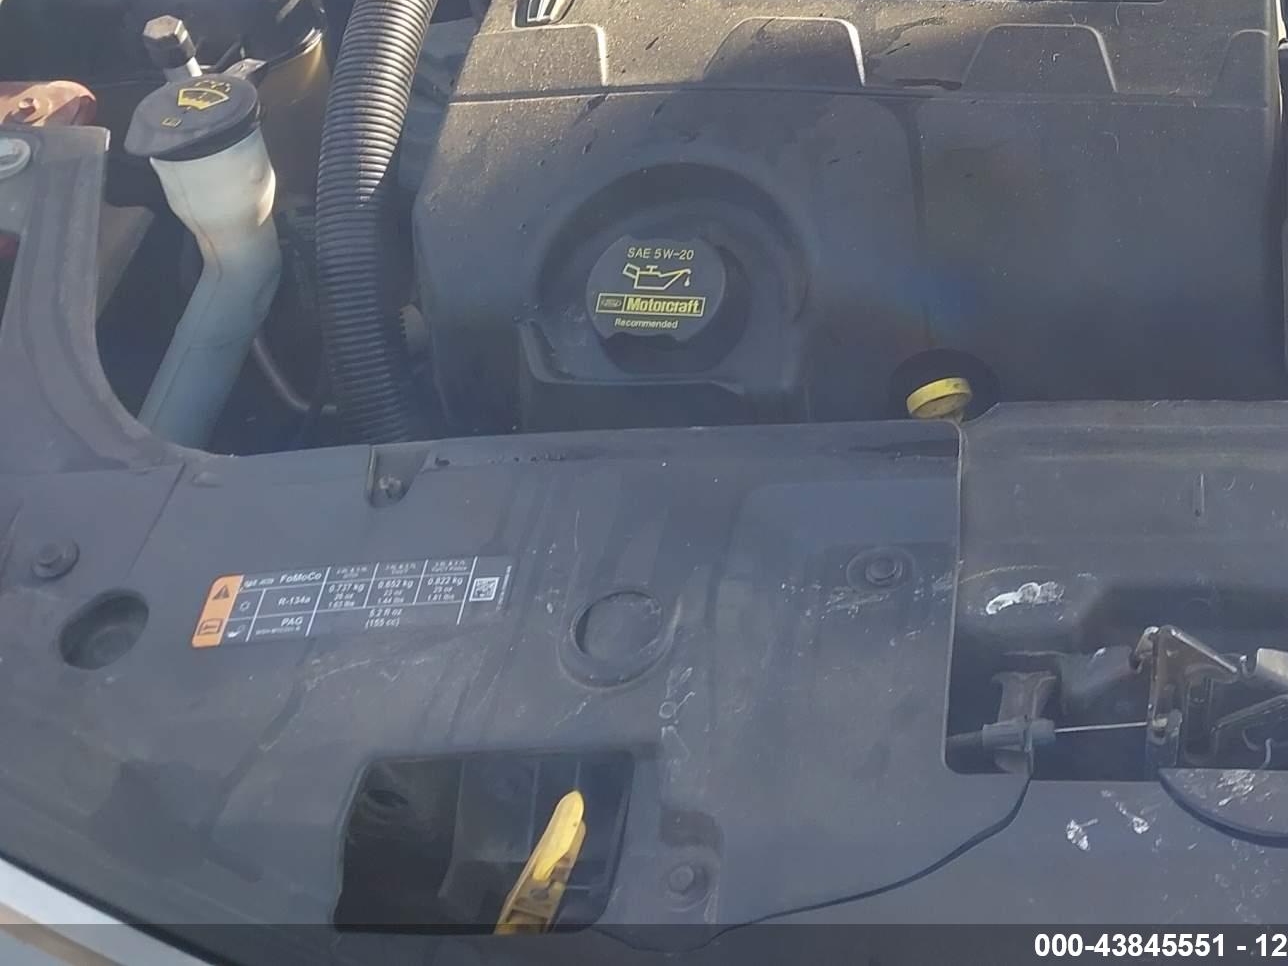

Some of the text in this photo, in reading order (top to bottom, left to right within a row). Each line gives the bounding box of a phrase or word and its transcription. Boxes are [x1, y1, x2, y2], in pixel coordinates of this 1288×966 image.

[627, 247, 695, 261] SAE 5W-20
[626, 296, 701, 314] Motorcraft
[614, 317, 679, 330] Recommended
[279, 572, 322, 584] FoMoCo
[452, 577, 463, 586] kg
[402, 580, 414, 589] kg
[278, 596, 311, 606] R-134a
[281, 616, 304, 627] PAG
